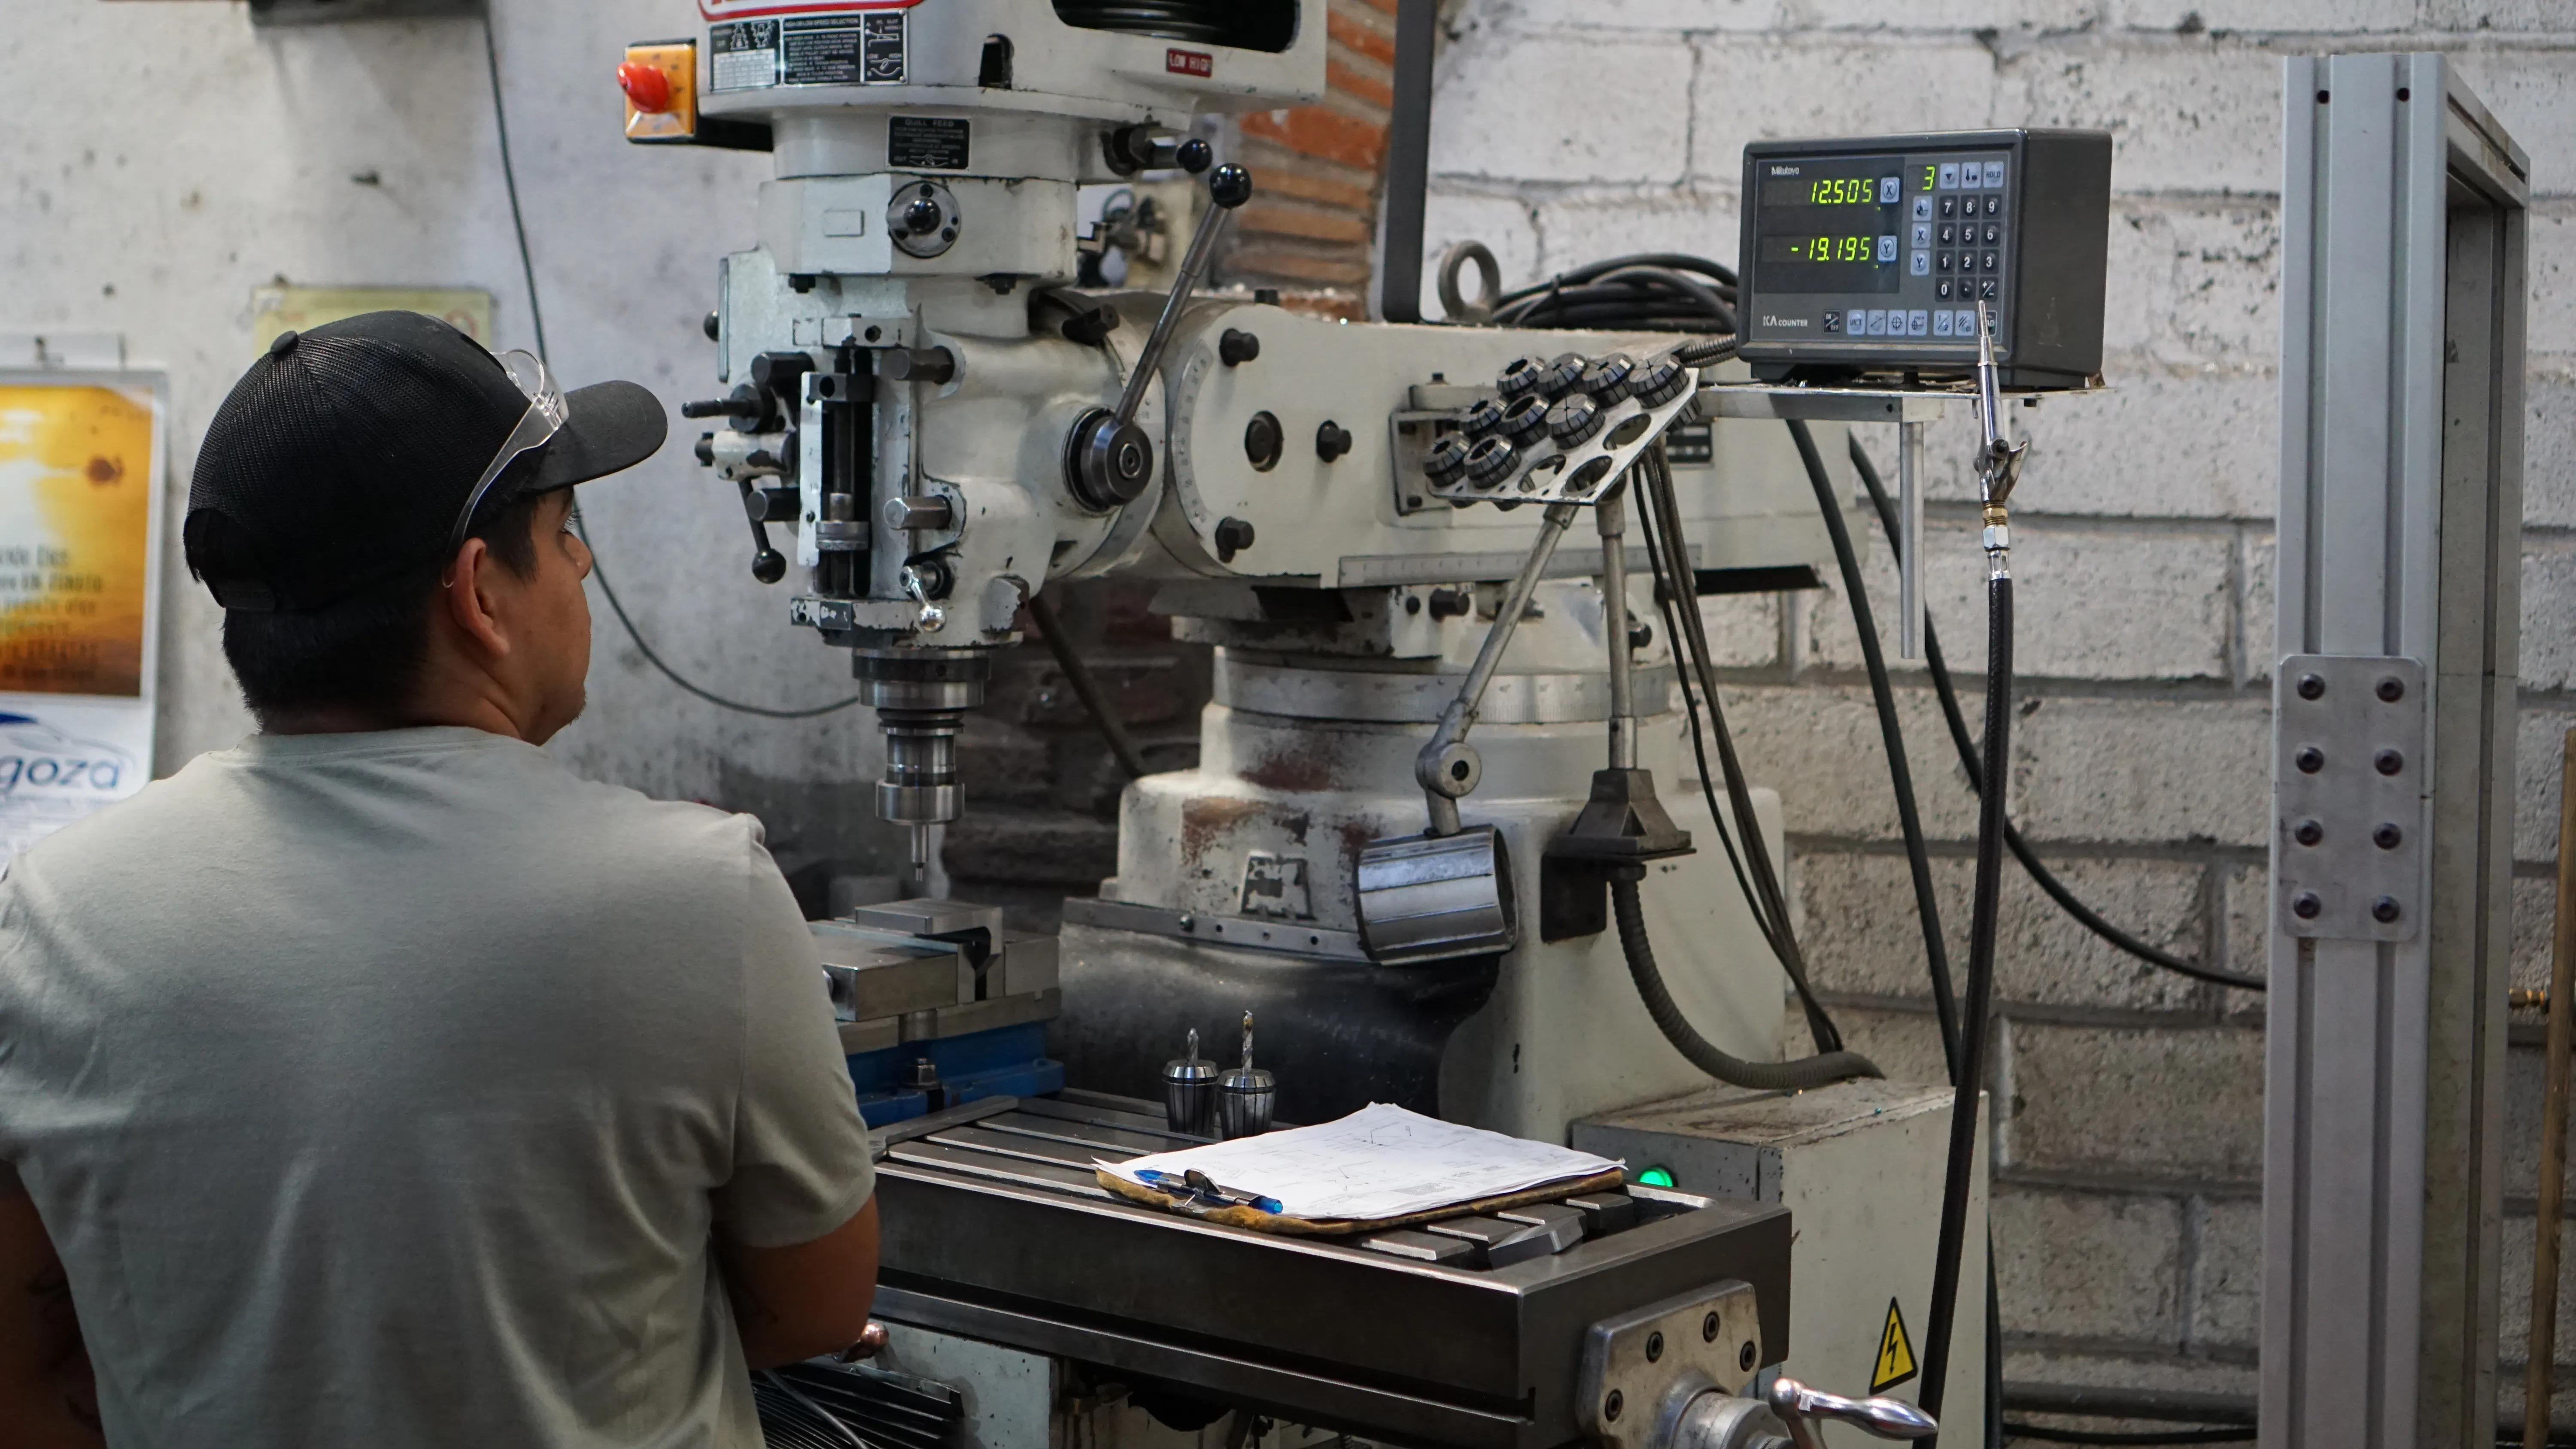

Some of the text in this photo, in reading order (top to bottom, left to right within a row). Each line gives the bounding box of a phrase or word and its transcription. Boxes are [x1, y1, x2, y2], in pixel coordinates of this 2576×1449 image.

[1771, 166, 1800, 176] Mitutoyo
[1922, 166, 1935, 191] 3
[1811, 179, 1873, 204] 12.505
[1886, 185, 1893, 195] X
[1944, 200, 1995, 214] 7 8 9
[1918, 230, 1924, 241] X
[1943, 229, 1993, 241] 4 5 6
[1883, 243, 1891, 254] Y
[1917, 257, 1923, 268] Y
[1942, 256, 1992, 268] 1 2 3
[1941, 283, 1947, 296] 0
[1778, 319, 1808, 327] COUNTER
[1850, 318, 1862, 327] UNIT
